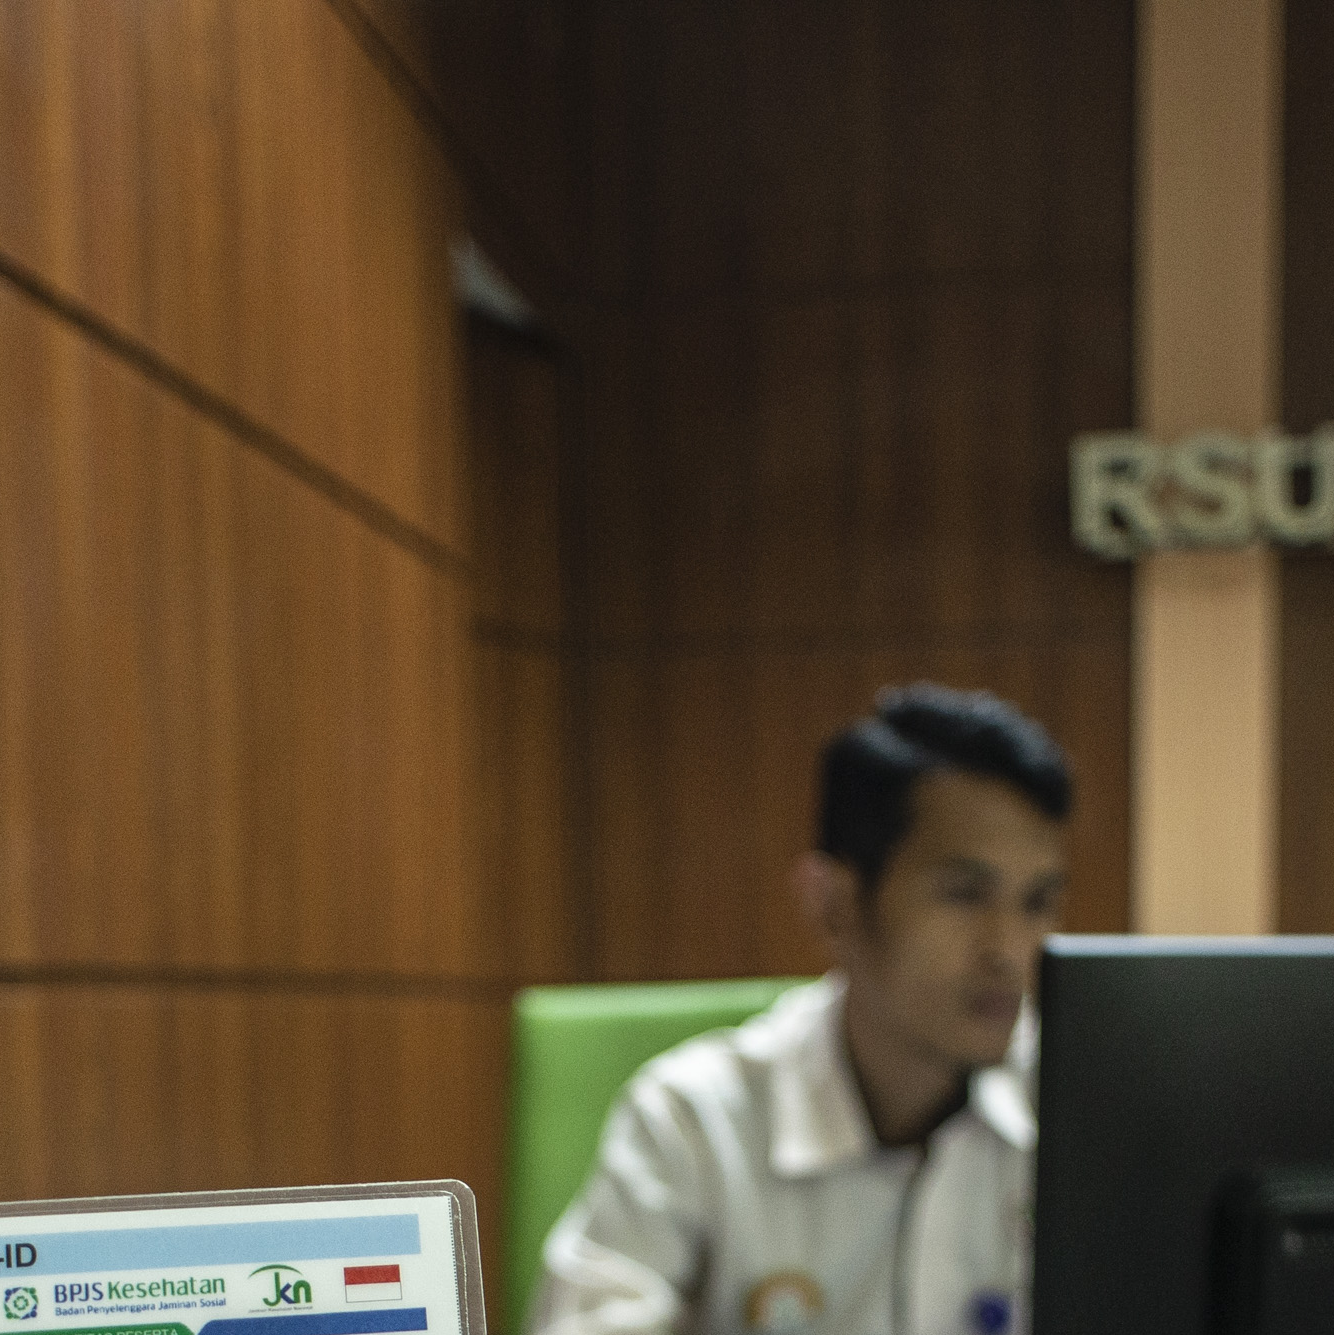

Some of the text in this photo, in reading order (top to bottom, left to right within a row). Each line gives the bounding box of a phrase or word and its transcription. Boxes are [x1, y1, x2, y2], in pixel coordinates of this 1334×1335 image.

[54, 1276, 226, 1304] BPJS Kesehatan
[55, 1297, 227, 1316] Badan Penyelenggara Jaminan Sosial
